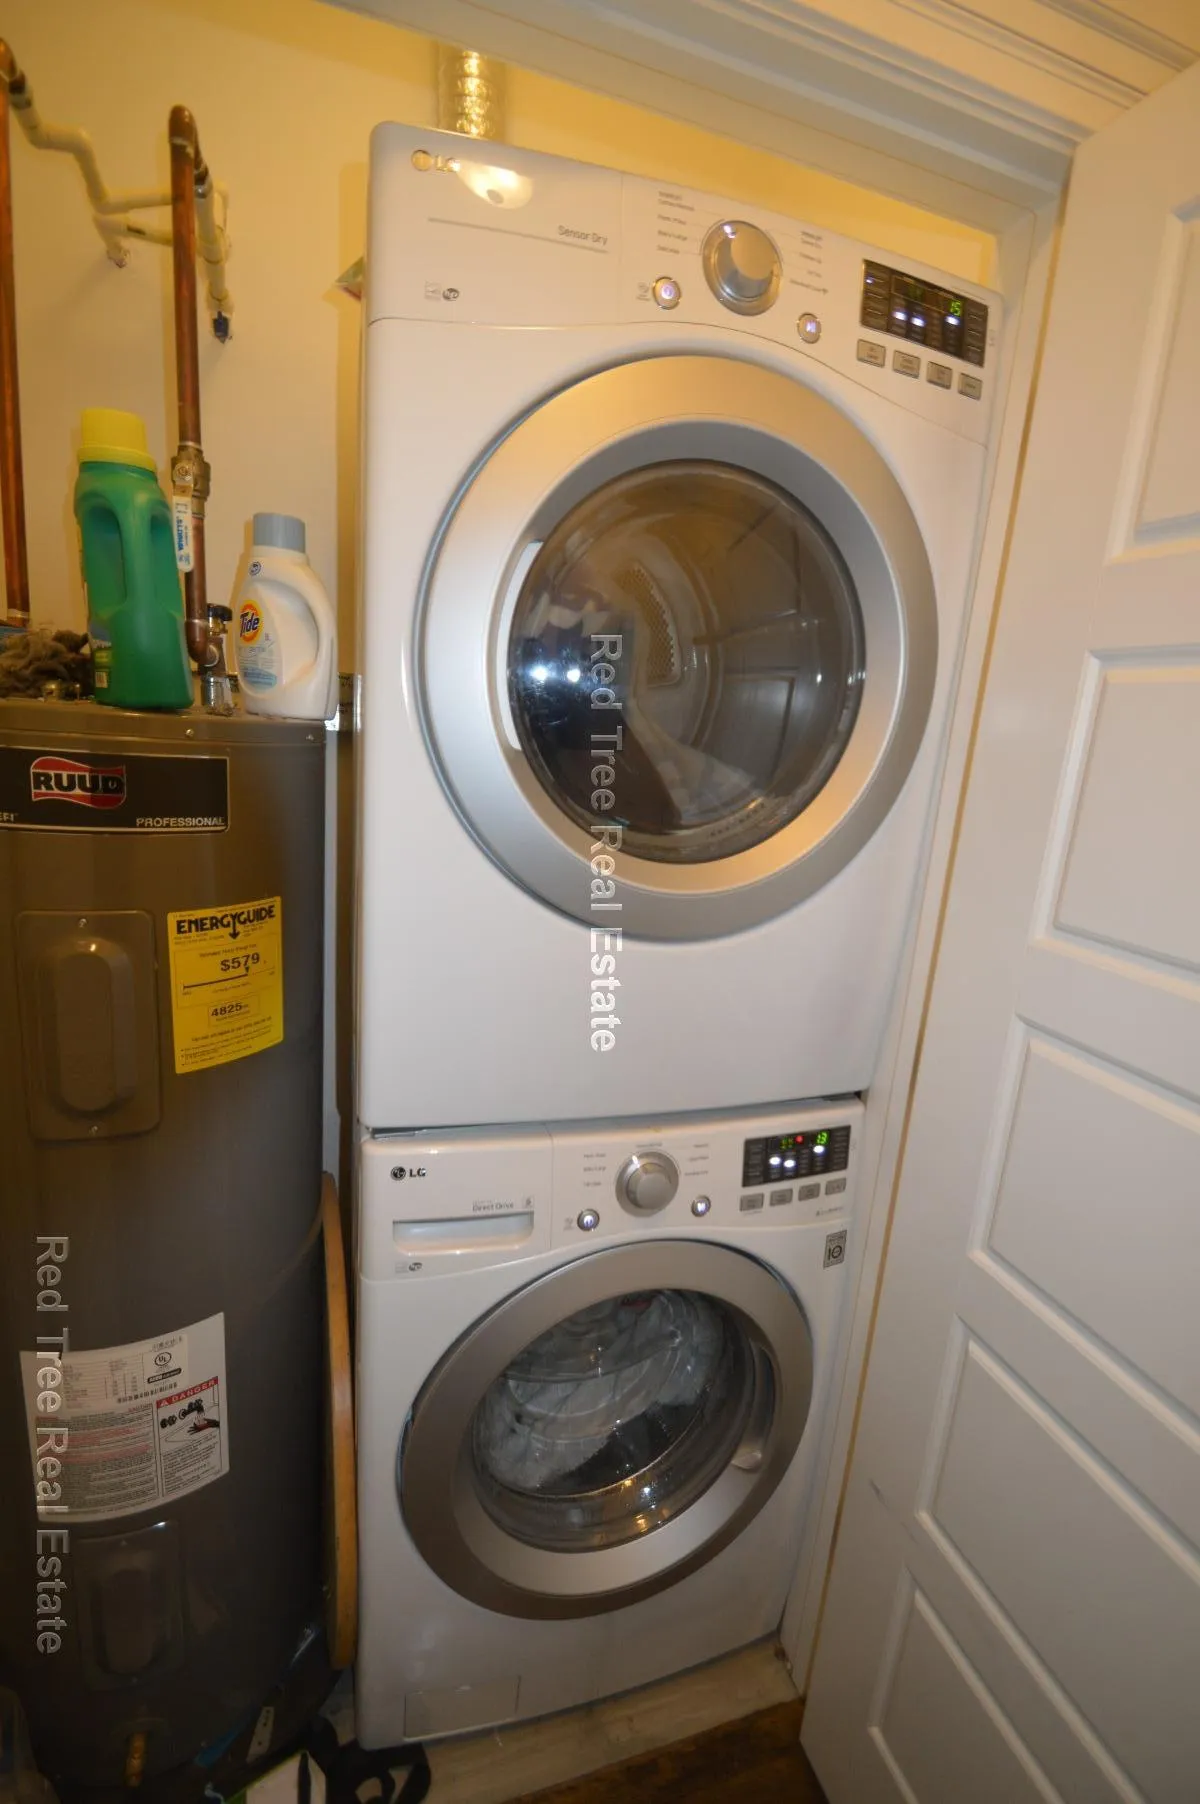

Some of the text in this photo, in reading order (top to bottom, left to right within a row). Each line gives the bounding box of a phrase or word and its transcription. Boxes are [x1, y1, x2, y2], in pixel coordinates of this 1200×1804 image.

[558, 225, 607, 246] Sensor Dry
[240, 611, 260, 637] Tide
[32, 771, 125, 794] RUUD
[136, 816, 225, 828] PROFESSIONAL
[220, 952, 260, 973] $579
[211, 1002, 243, 1018] 4825
[409, 1168, 427, 1178] LG
[473, 1202, 495, 1212] Direct
[495, 1200, 514, 1210] Drive
[172, 1378, 216, 1402] DANGER
